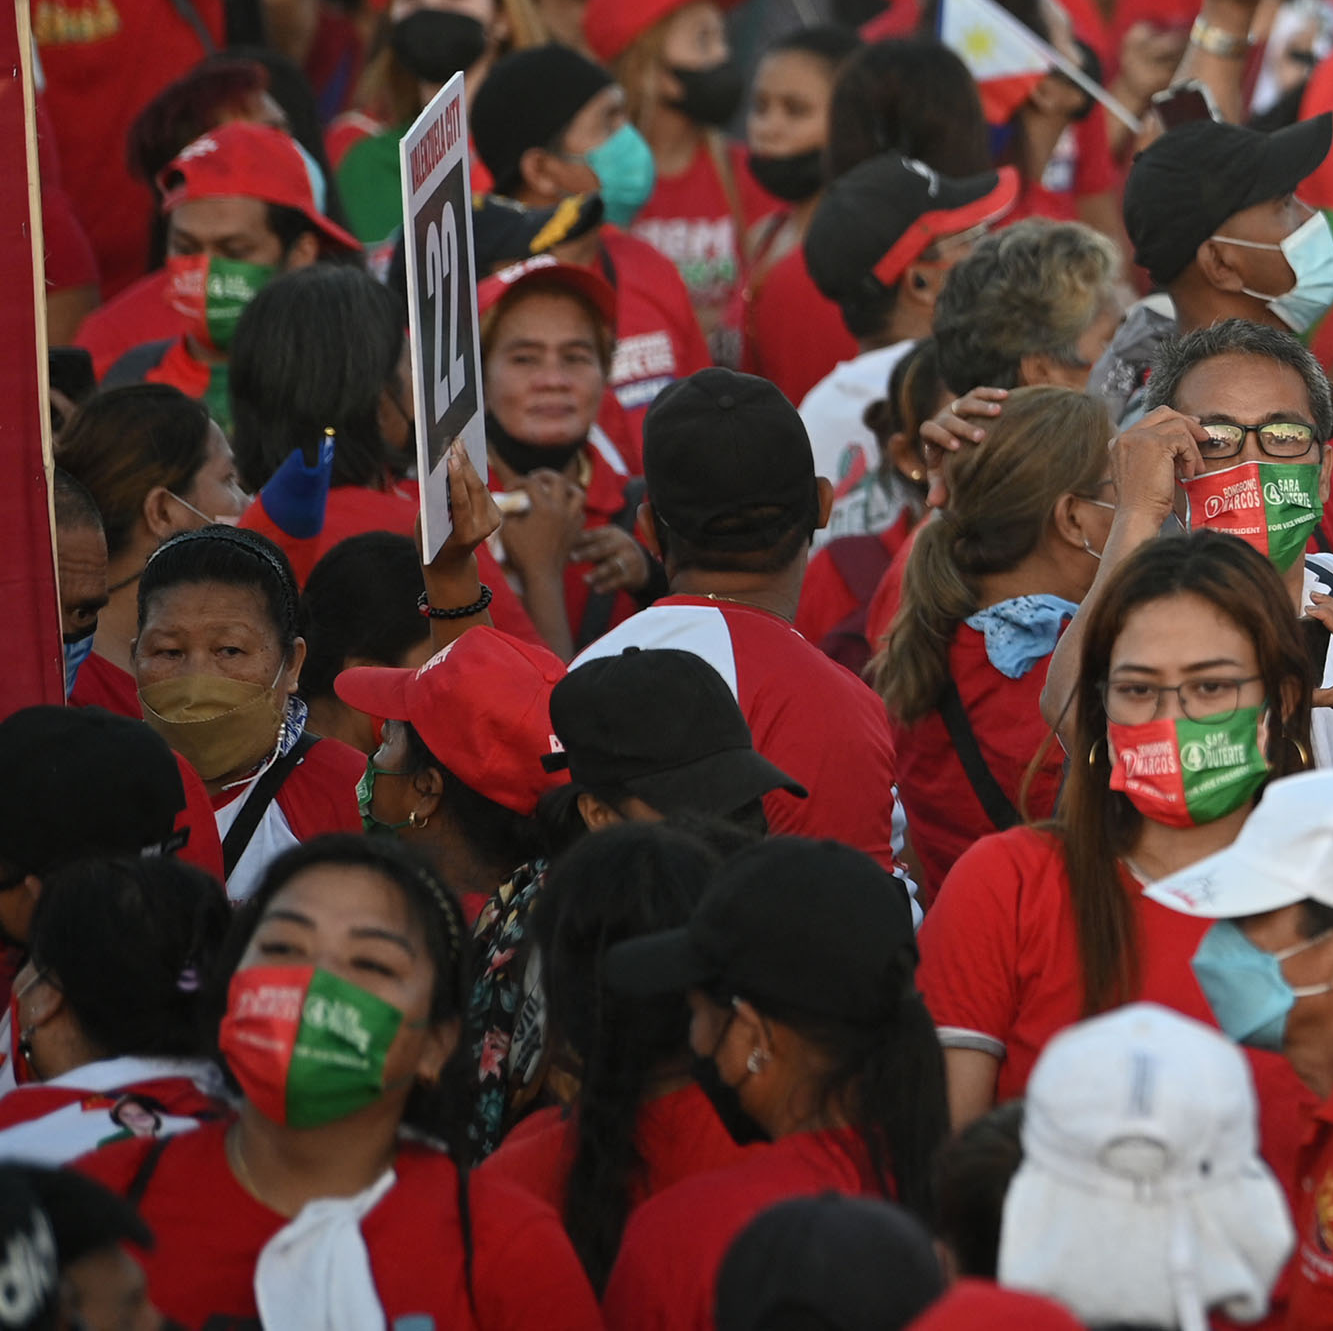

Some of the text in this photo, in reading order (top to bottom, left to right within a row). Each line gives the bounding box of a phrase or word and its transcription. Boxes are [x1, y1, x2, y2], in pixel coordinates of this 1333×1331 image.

[426, 200, 465, 425] 22
[1278, 479, 1300, 491] SARA
[1268, 523, 1282, 532] FOR
[1206, 744, 1246, 768] DUTERTE
